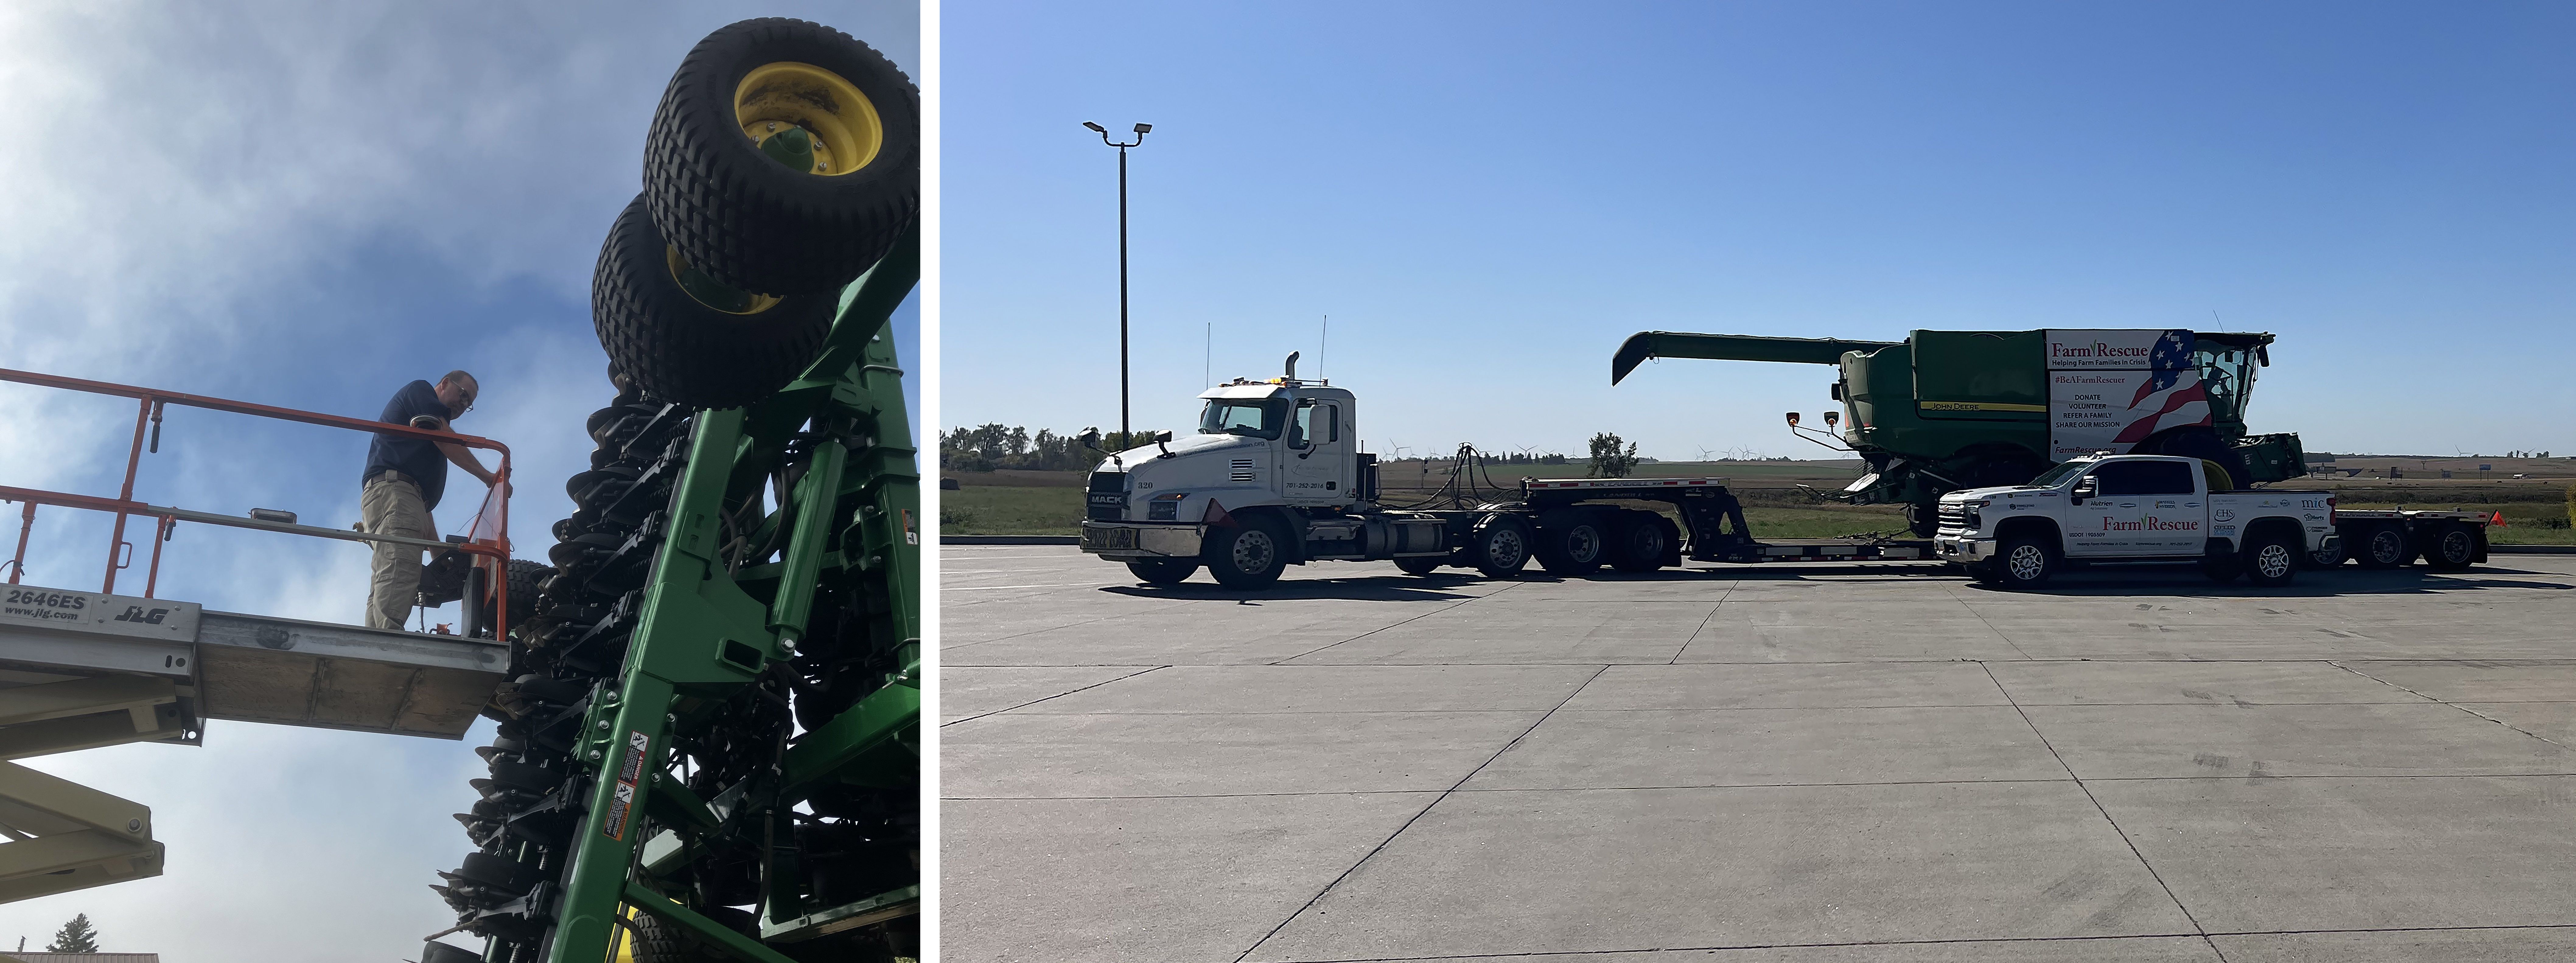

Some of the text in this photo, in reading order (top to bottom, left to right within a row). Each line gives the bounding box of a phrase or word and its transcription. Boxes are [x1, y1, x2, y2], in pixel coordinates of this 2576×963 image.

[2052, 343, 2148, 357] Farm Rescue
[2302, 497, 2324, 508] mic
[2216, 509, 2234, 517] CHS
[2103, 517, 2198, 530] Farm Rescue
[7, 590, 86, 609] 2646ES
[5, 607, 78, 620] www.jlg.com
[114, 606, 169, 624] JLG
[618, 812, 627, 834] WARNING
